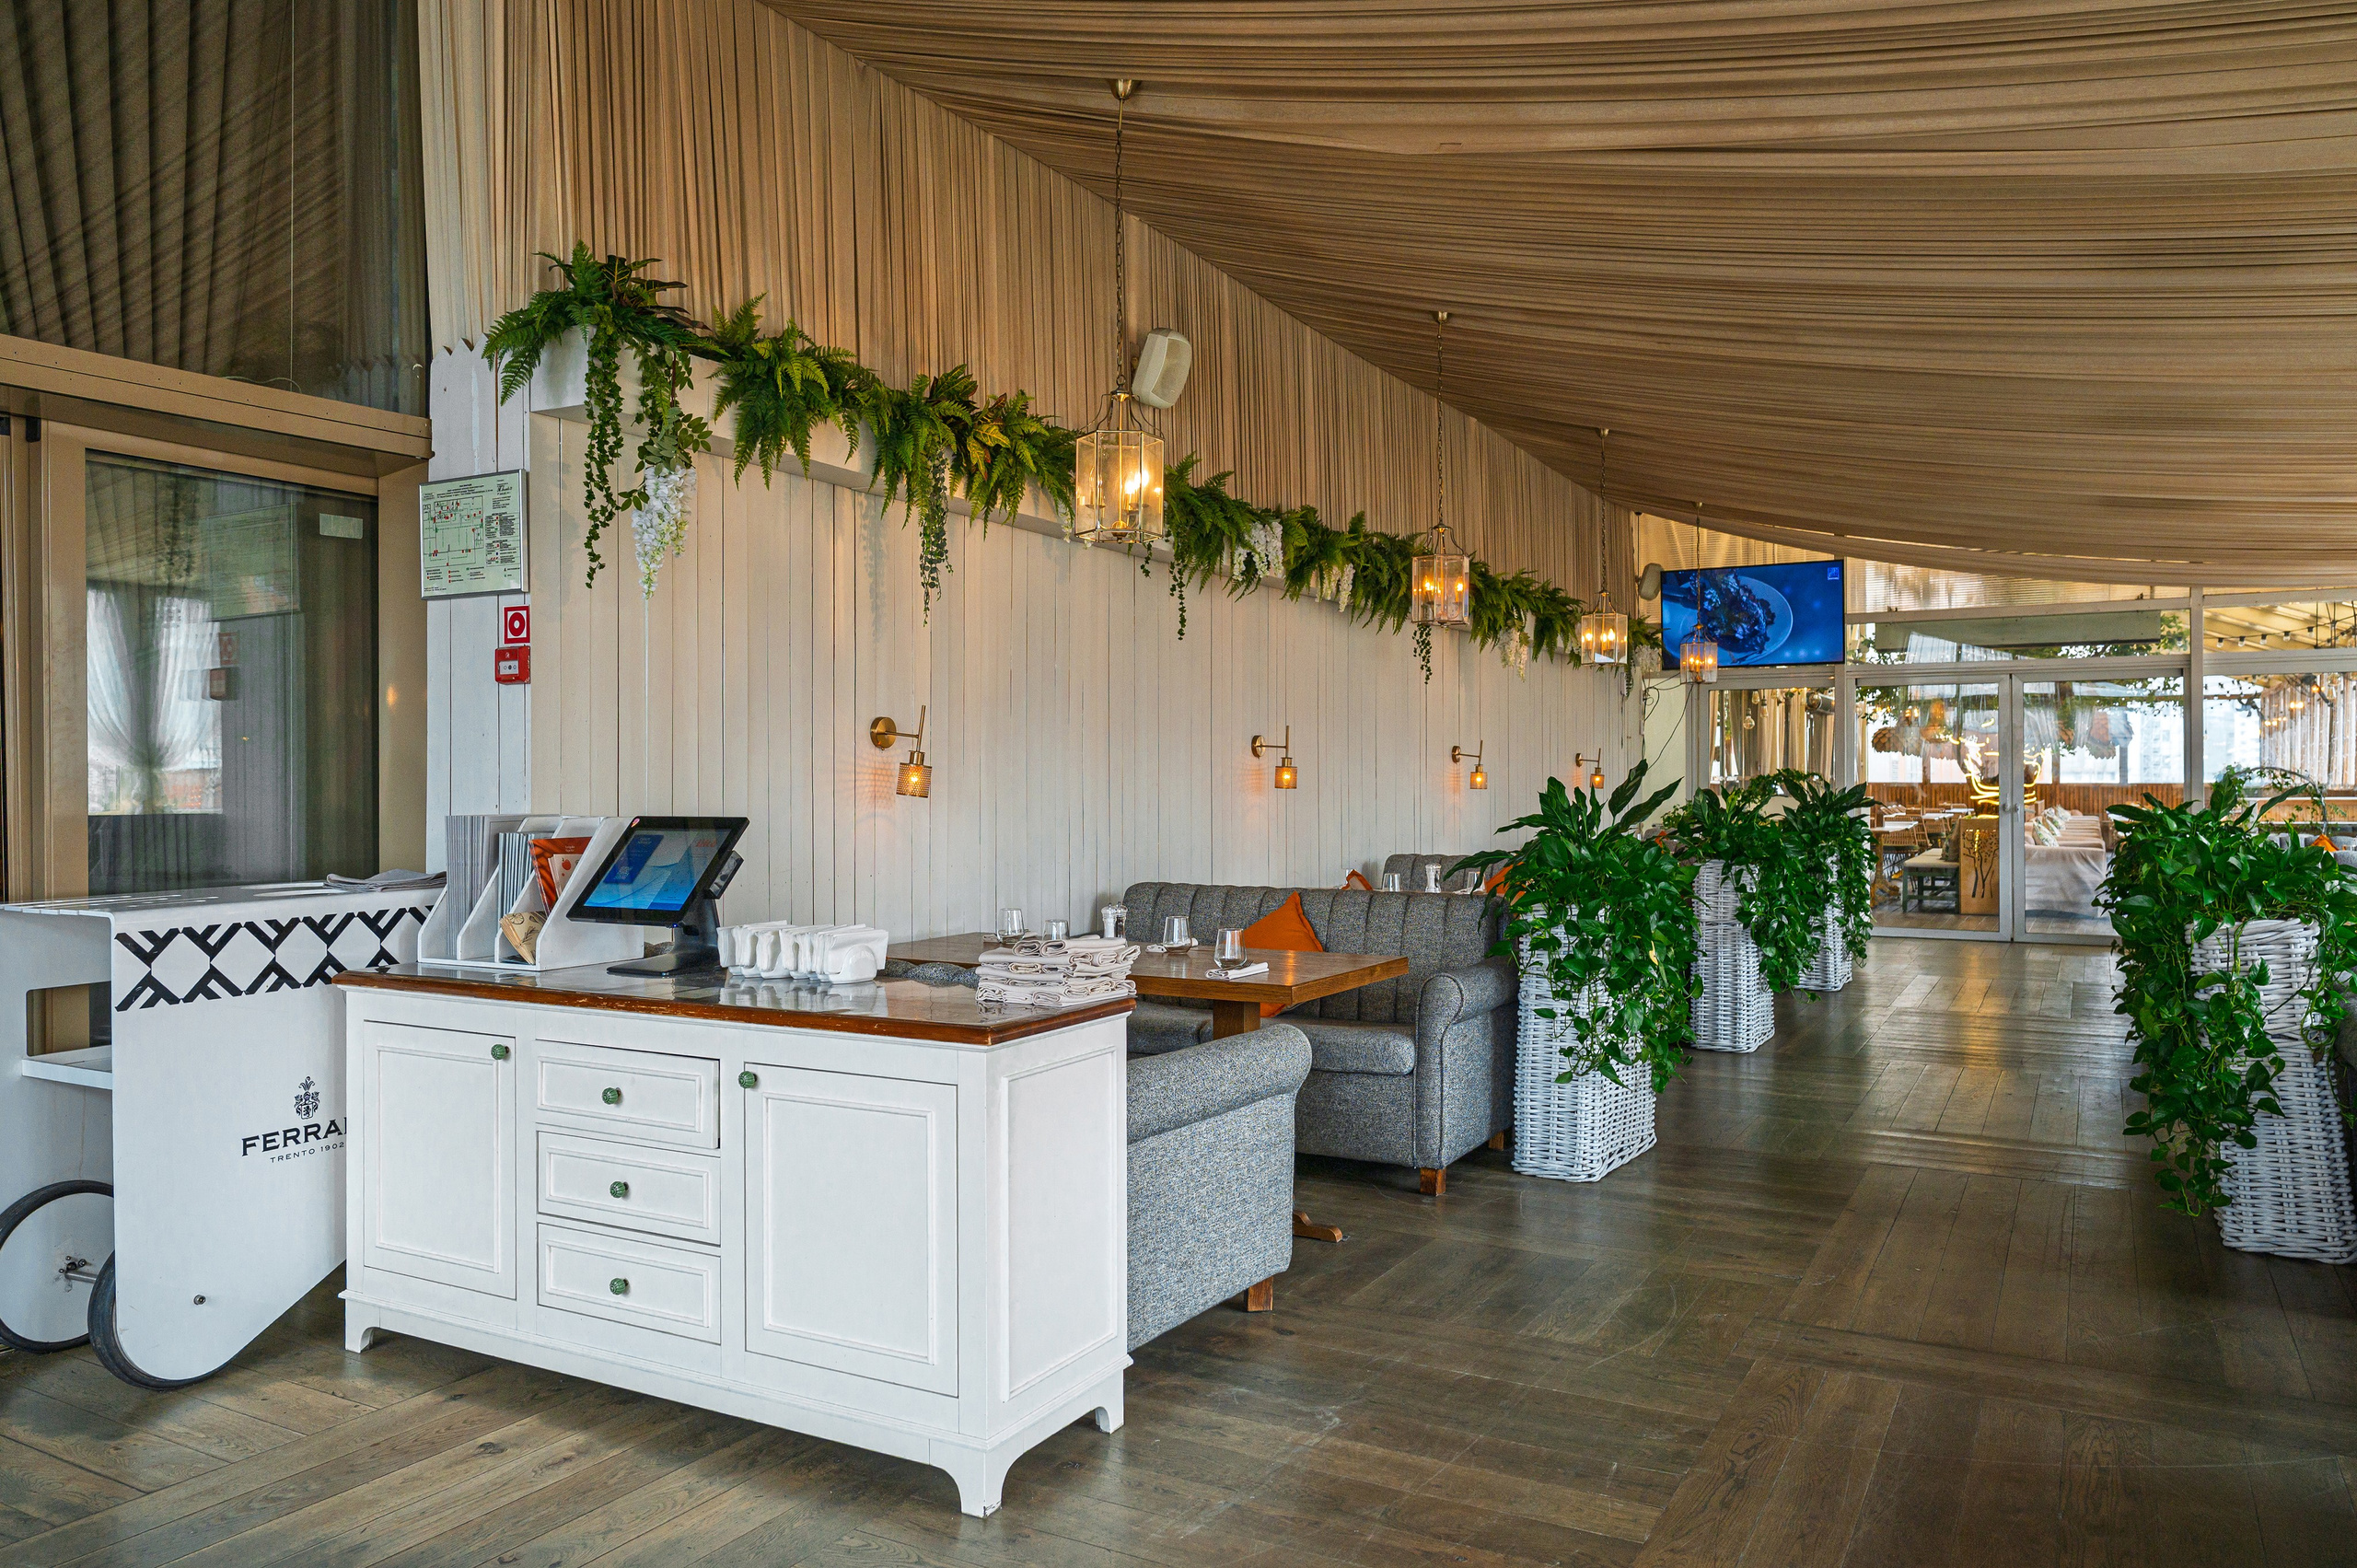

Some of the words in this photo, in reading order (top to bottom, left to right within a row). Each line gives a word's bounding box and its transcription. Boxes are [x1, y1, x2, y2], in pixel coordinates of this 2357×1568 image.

[241, 1117, 346, 1156] FERRA
[270, 1148, 316, 1163] TRENTO
[320, 1142, 344, 1152] 1902
